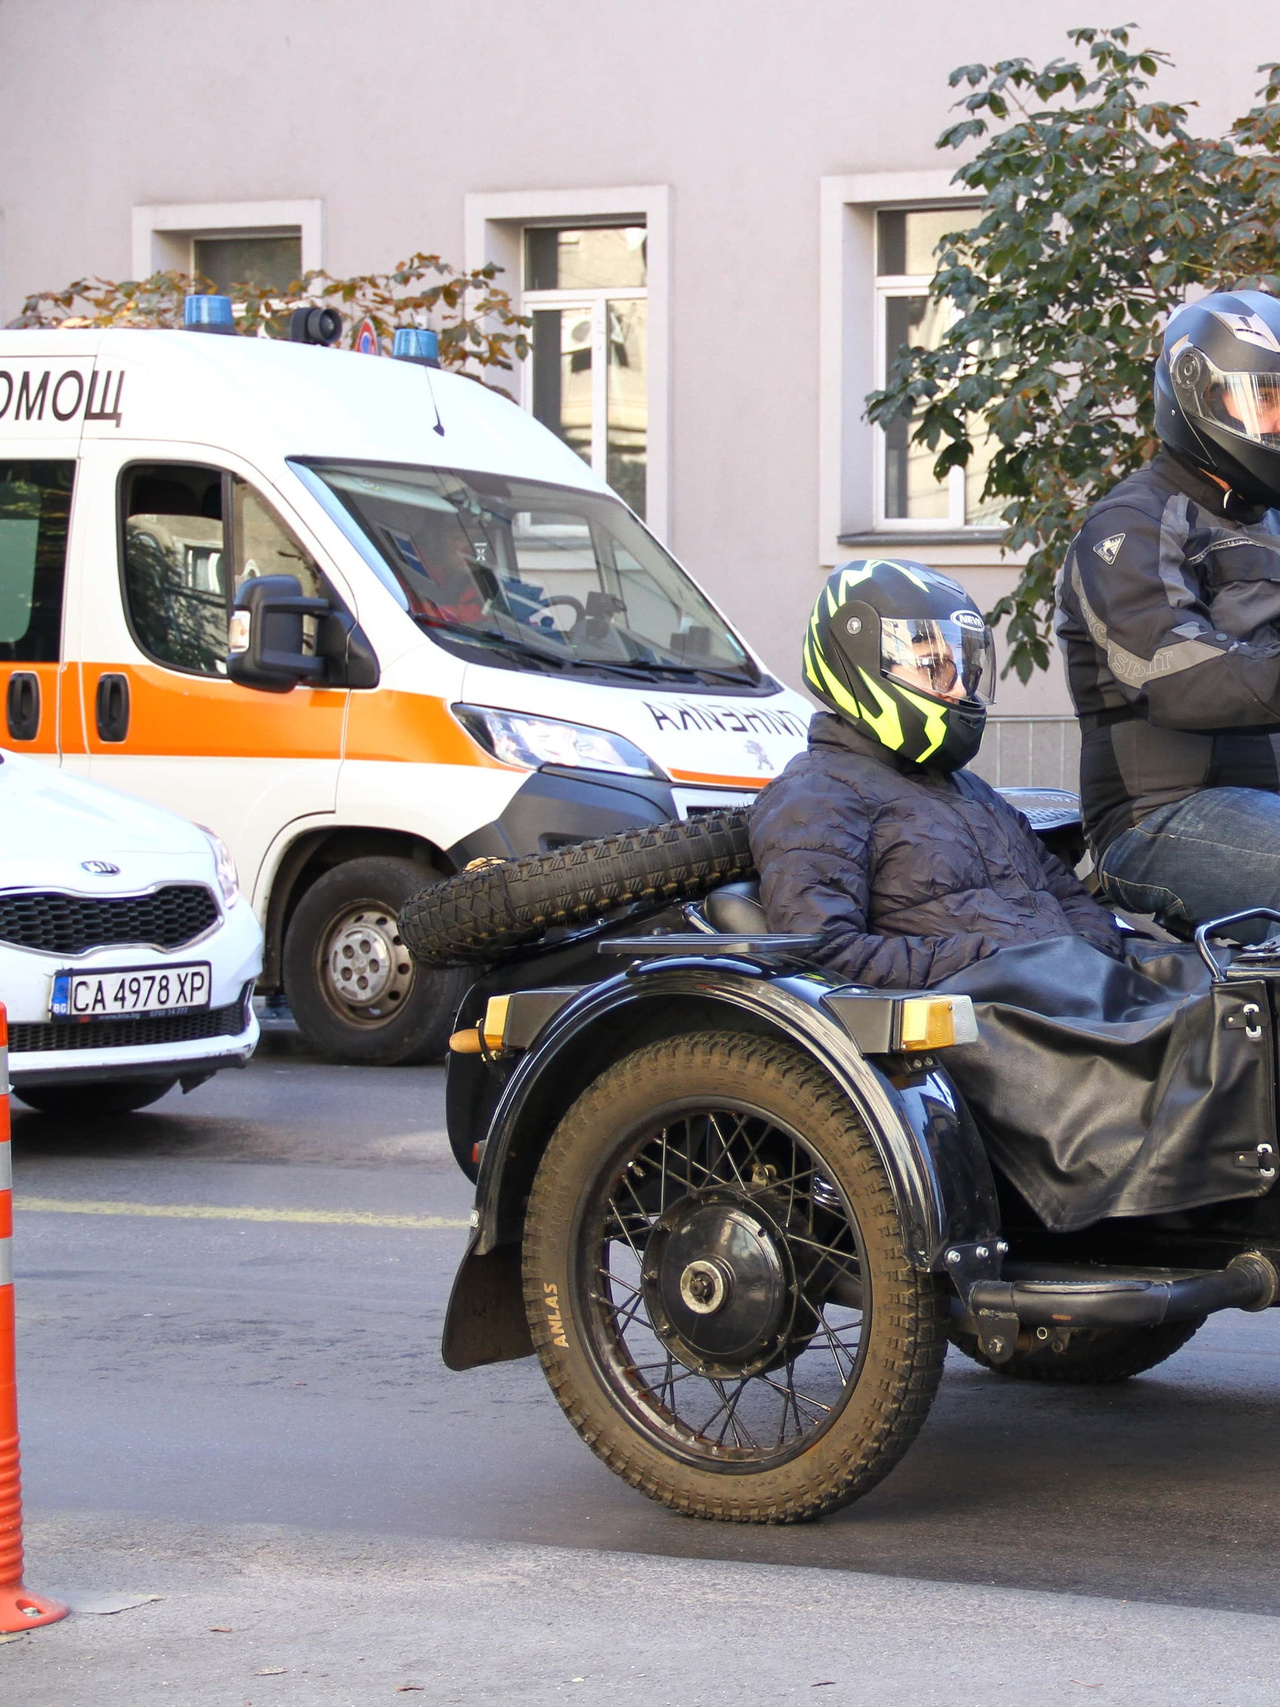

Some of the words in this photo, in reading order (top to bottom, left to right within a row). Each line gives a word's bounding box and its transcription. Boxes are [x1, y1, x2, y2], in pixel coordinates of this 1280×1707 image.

[53, 1003, 67, 1013] BG
[73, 980, 106, 1012] CA
[113, 975, 170, 1009] 4978
[176, 971, 205, 1004] XP
[543, 1282, 569, 1348] ANLAS
